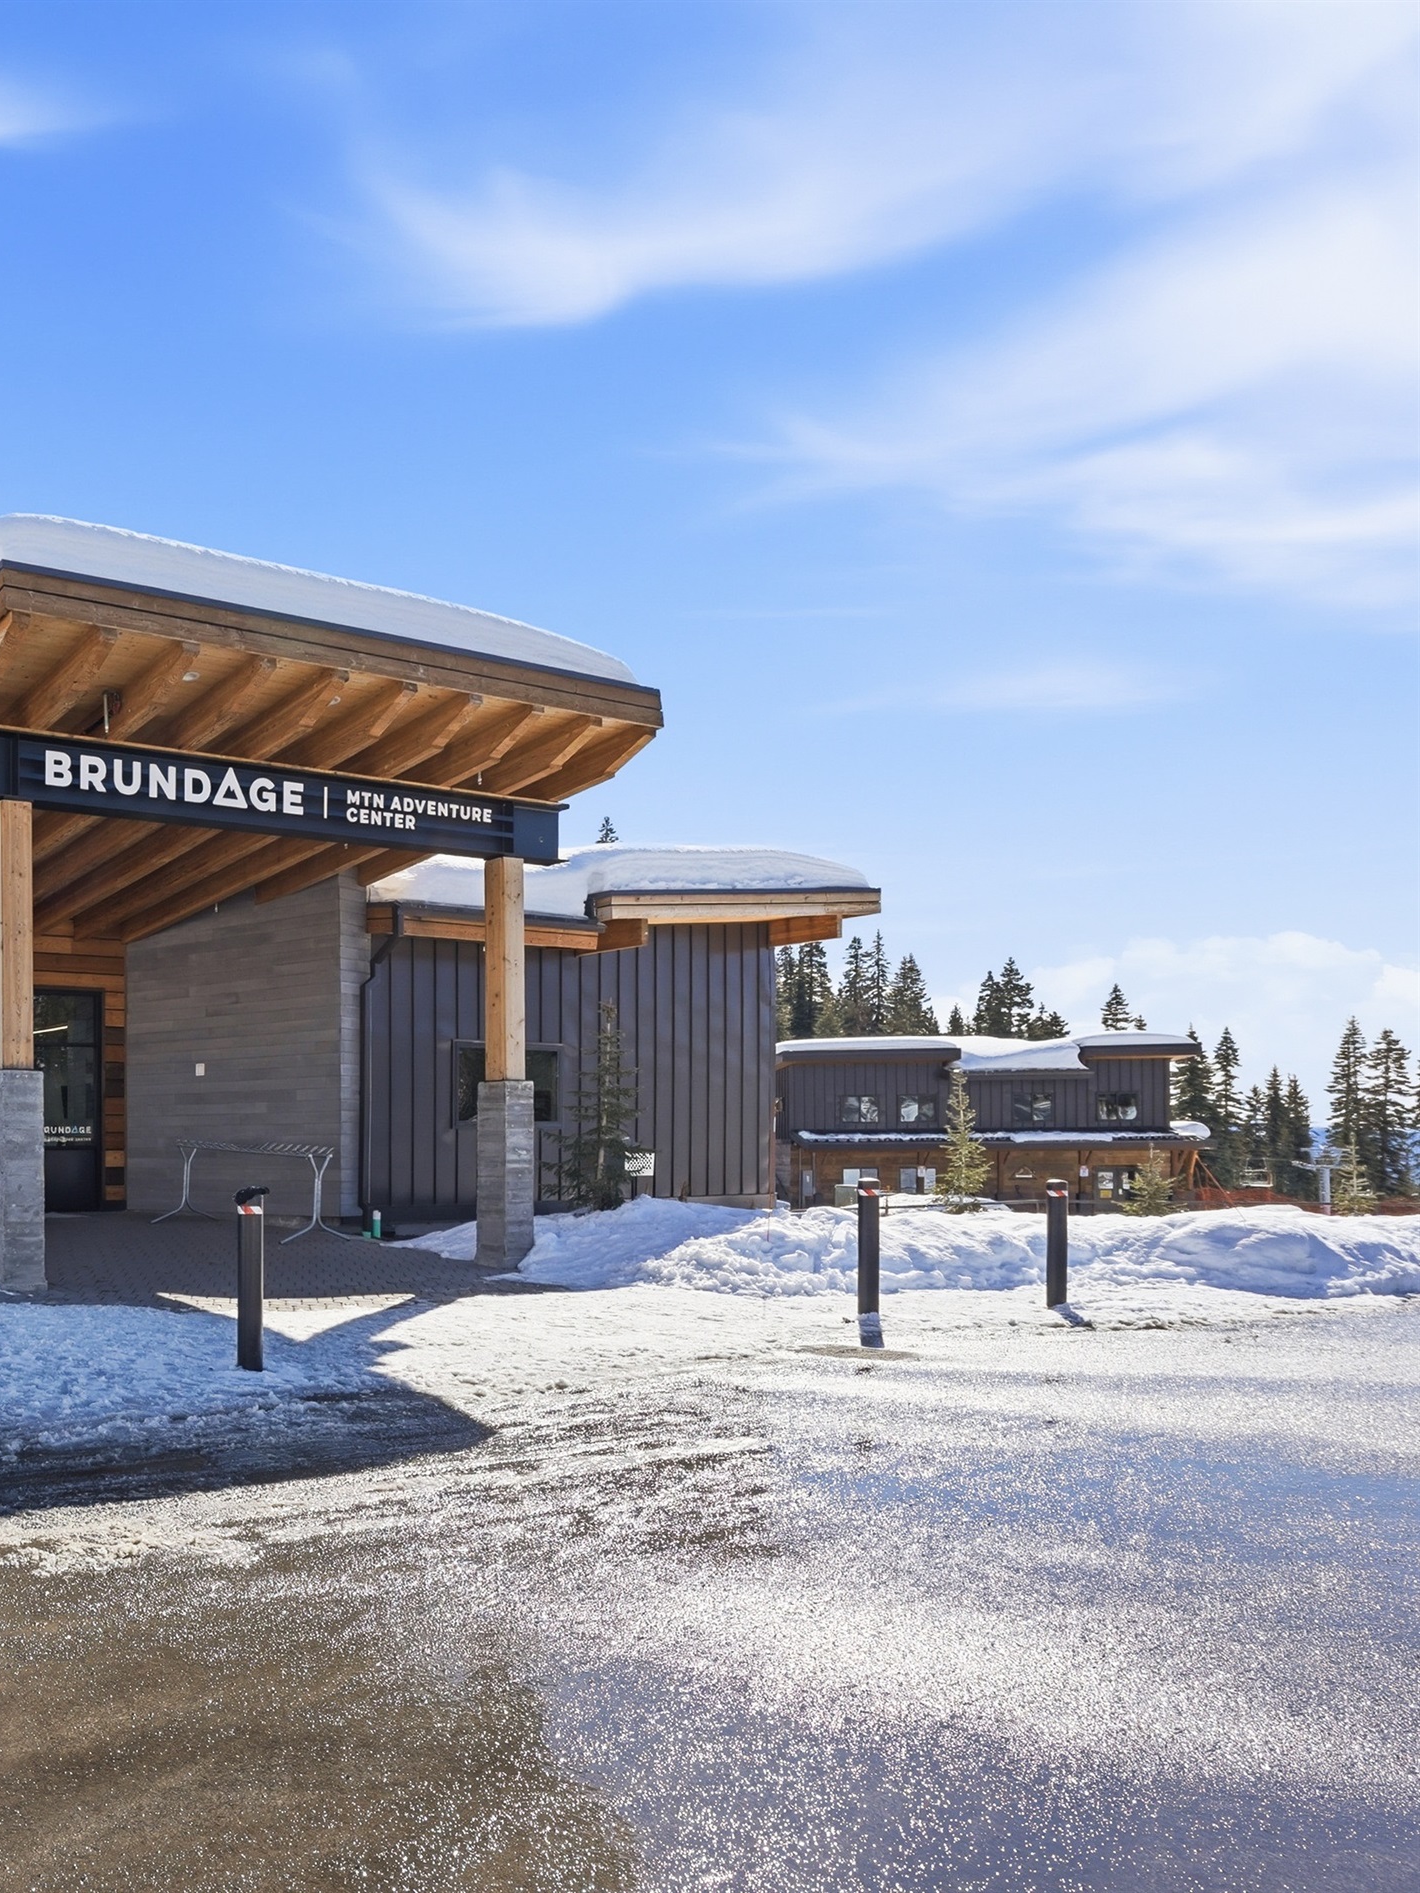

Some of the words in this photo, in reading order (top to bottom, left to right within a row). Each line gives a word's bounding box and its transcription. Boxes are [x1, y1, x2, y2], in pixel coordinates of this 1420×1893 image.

[45, 750, 304, 815] BRUNDAGE
[346, 807, 416, 830] CENTER
[347, 789, 385, 809] MTN
[390, 796, 492, 823] ADVENTURE
[44, 1125, 91, 1134] RUNDAGE
